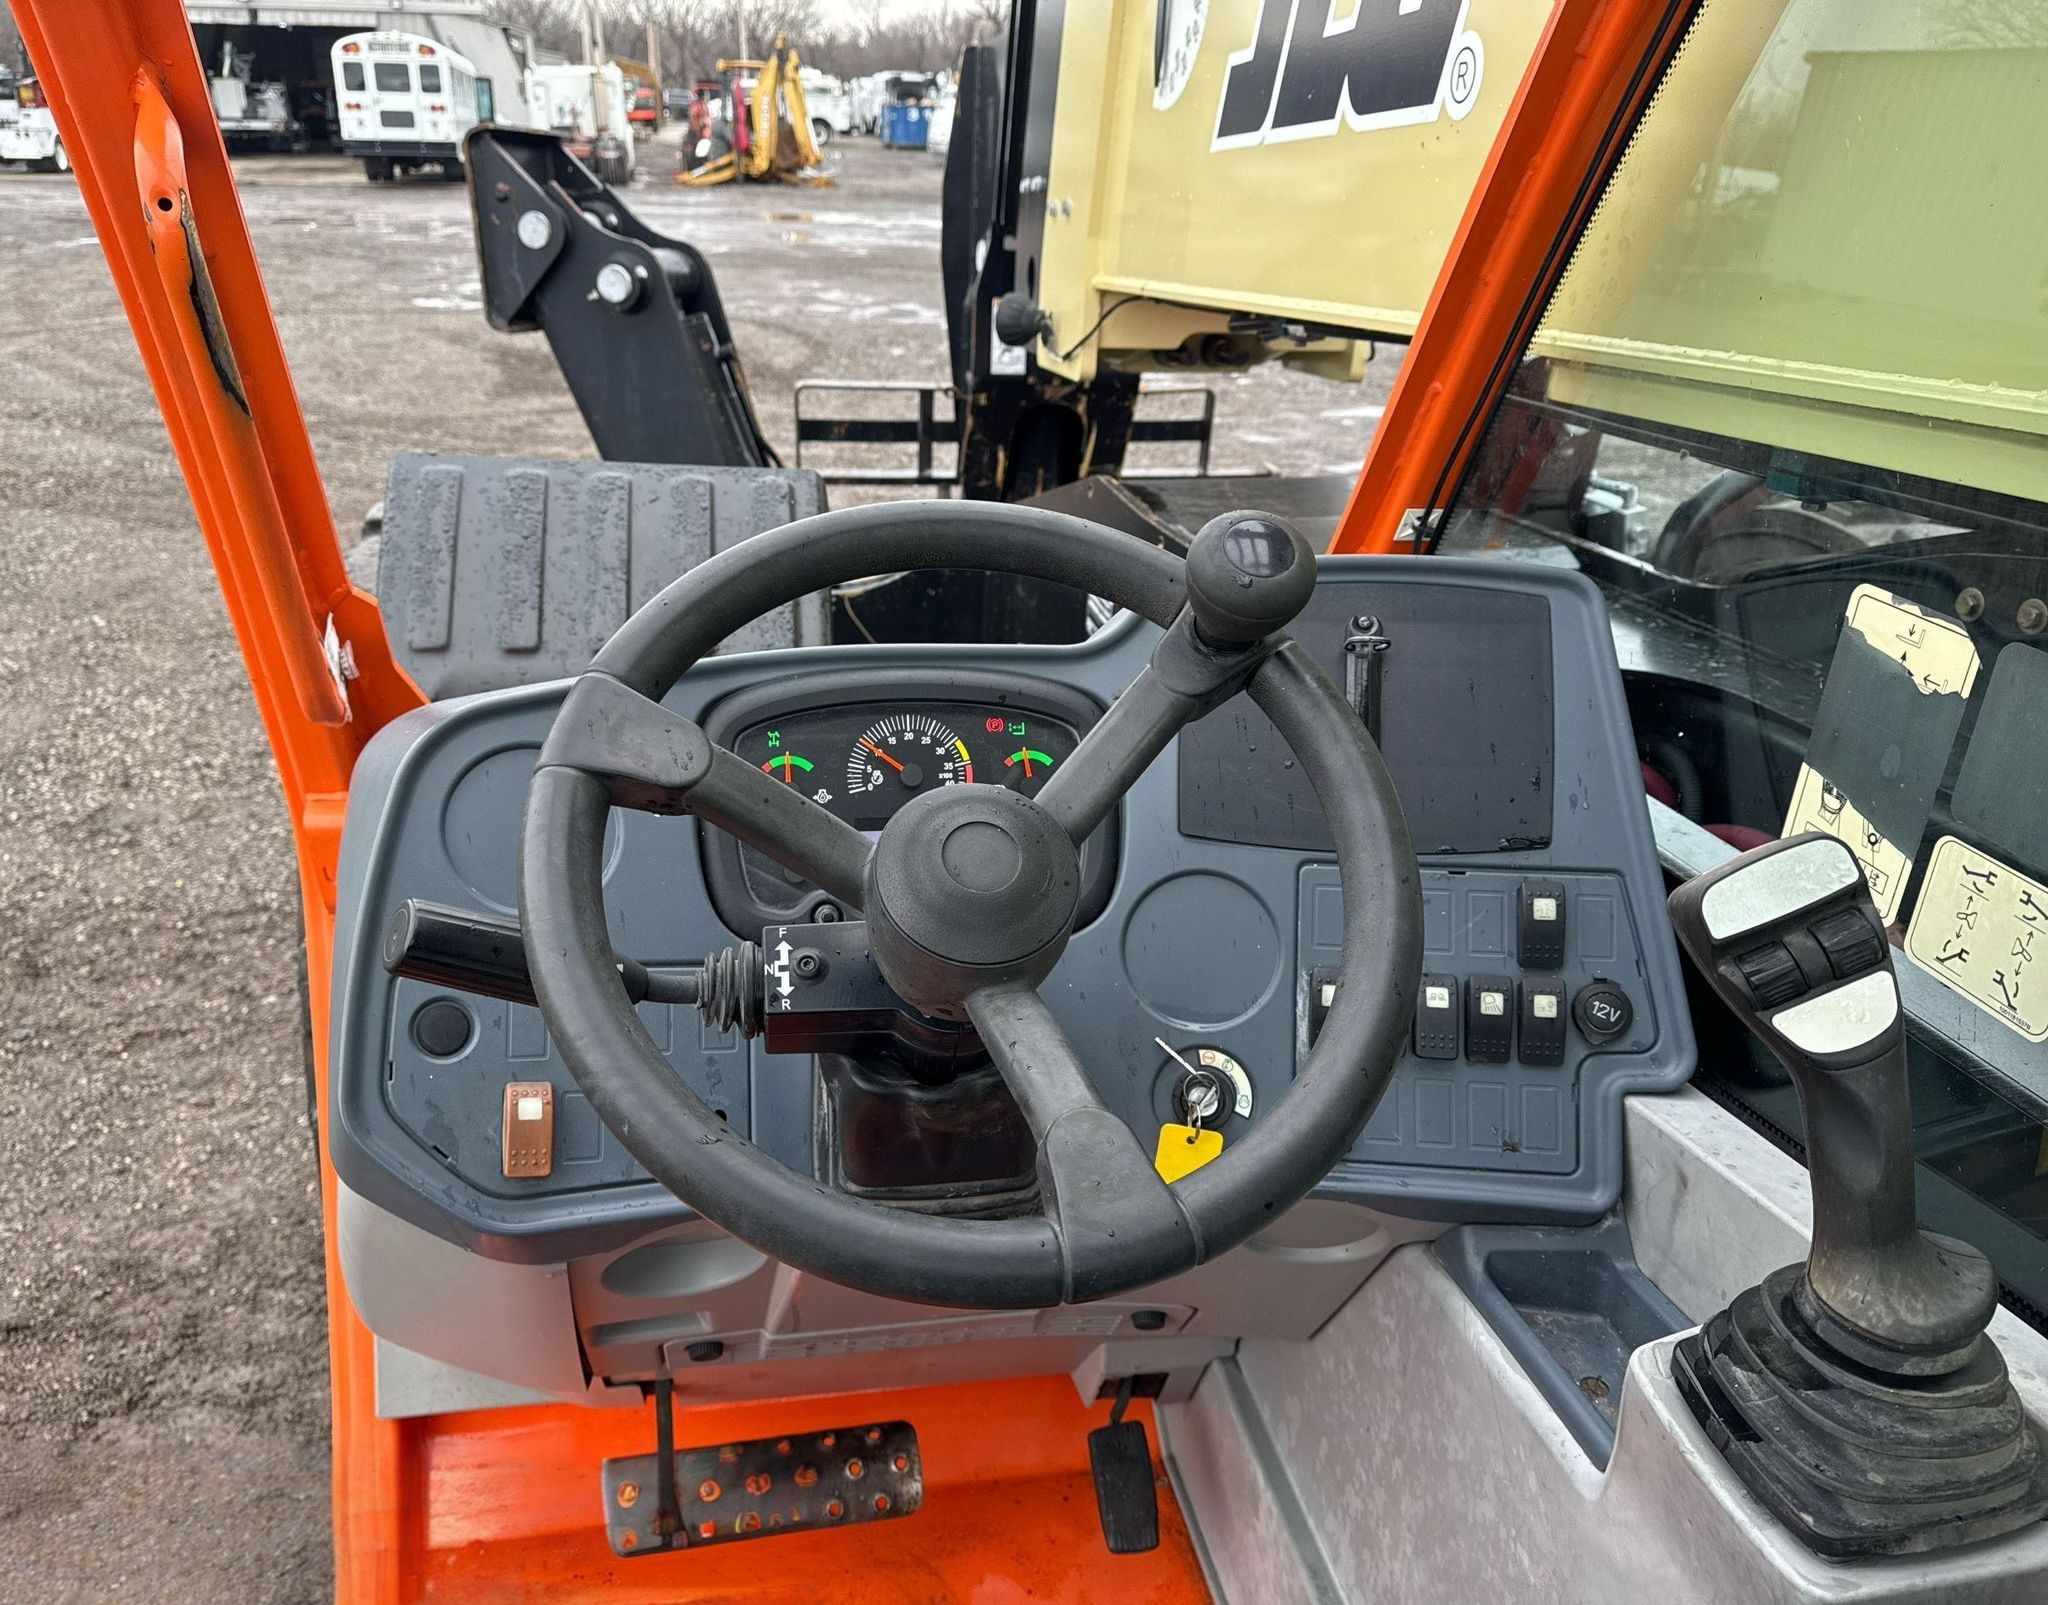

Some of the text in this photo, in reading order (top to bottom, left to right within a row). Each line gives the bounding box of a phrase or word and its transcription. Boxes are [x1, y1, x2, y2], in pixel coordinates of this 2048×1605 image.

[903, 732, 914, 740] 20
[920, 736, 931, 744] 25
[887, 736, 897, 745] 15
[935, 747, 946, 755] 30
[866, 765, 873, 773] 5
[943, 762, 954, 770] 35
[867, 783, 874, 791] 0
[778, 927, 788, 939] F
[764, 963, 775, 976] N
[781, 999, 791, 1011] R
[1592, 1000, 1622, 1023] 12V
